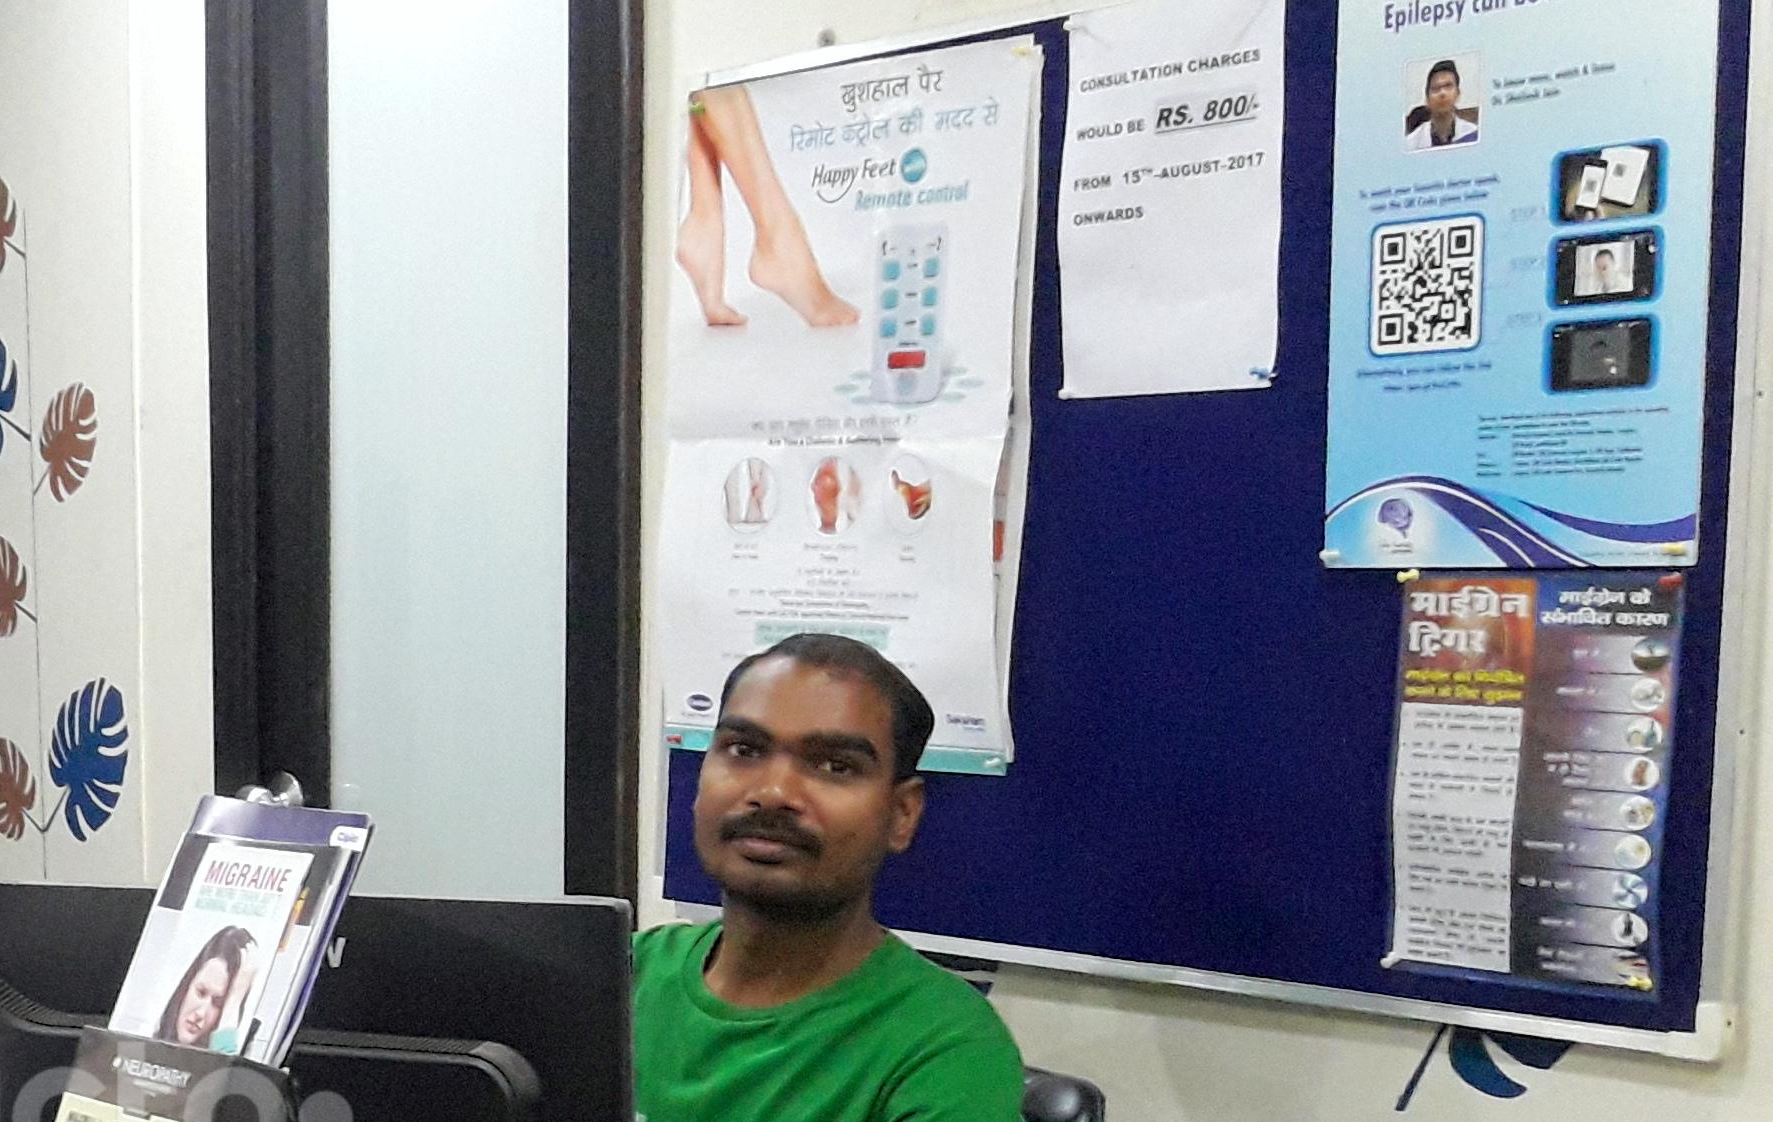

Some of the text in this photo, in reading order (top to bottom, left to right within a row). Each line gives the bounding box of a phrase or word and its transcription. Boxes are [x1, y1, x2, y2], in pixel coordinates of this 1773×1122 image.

[1384, 1, 1464, 33] Epilepsy
[1080, 49, 1261, 93] CONSULTATION CHARGES
[840, 67, 945, 112] खुशहाल पैर
[898, 106, 923, 135] की
[934, 107, 976, 130] मदद
[983, 96, 1000, 126] से
[1077, 93, 1260, 141] WOULD BE RS. 800/-
[812, 158, 897, 196] Happy Feet
[1074, 175, 1111, 192] FROM
[855, 180, 970, 211] Remote control
[1073, 205, 1145, 226] ONWARDS
[204, 860, 293, 892] MIGRAINE
